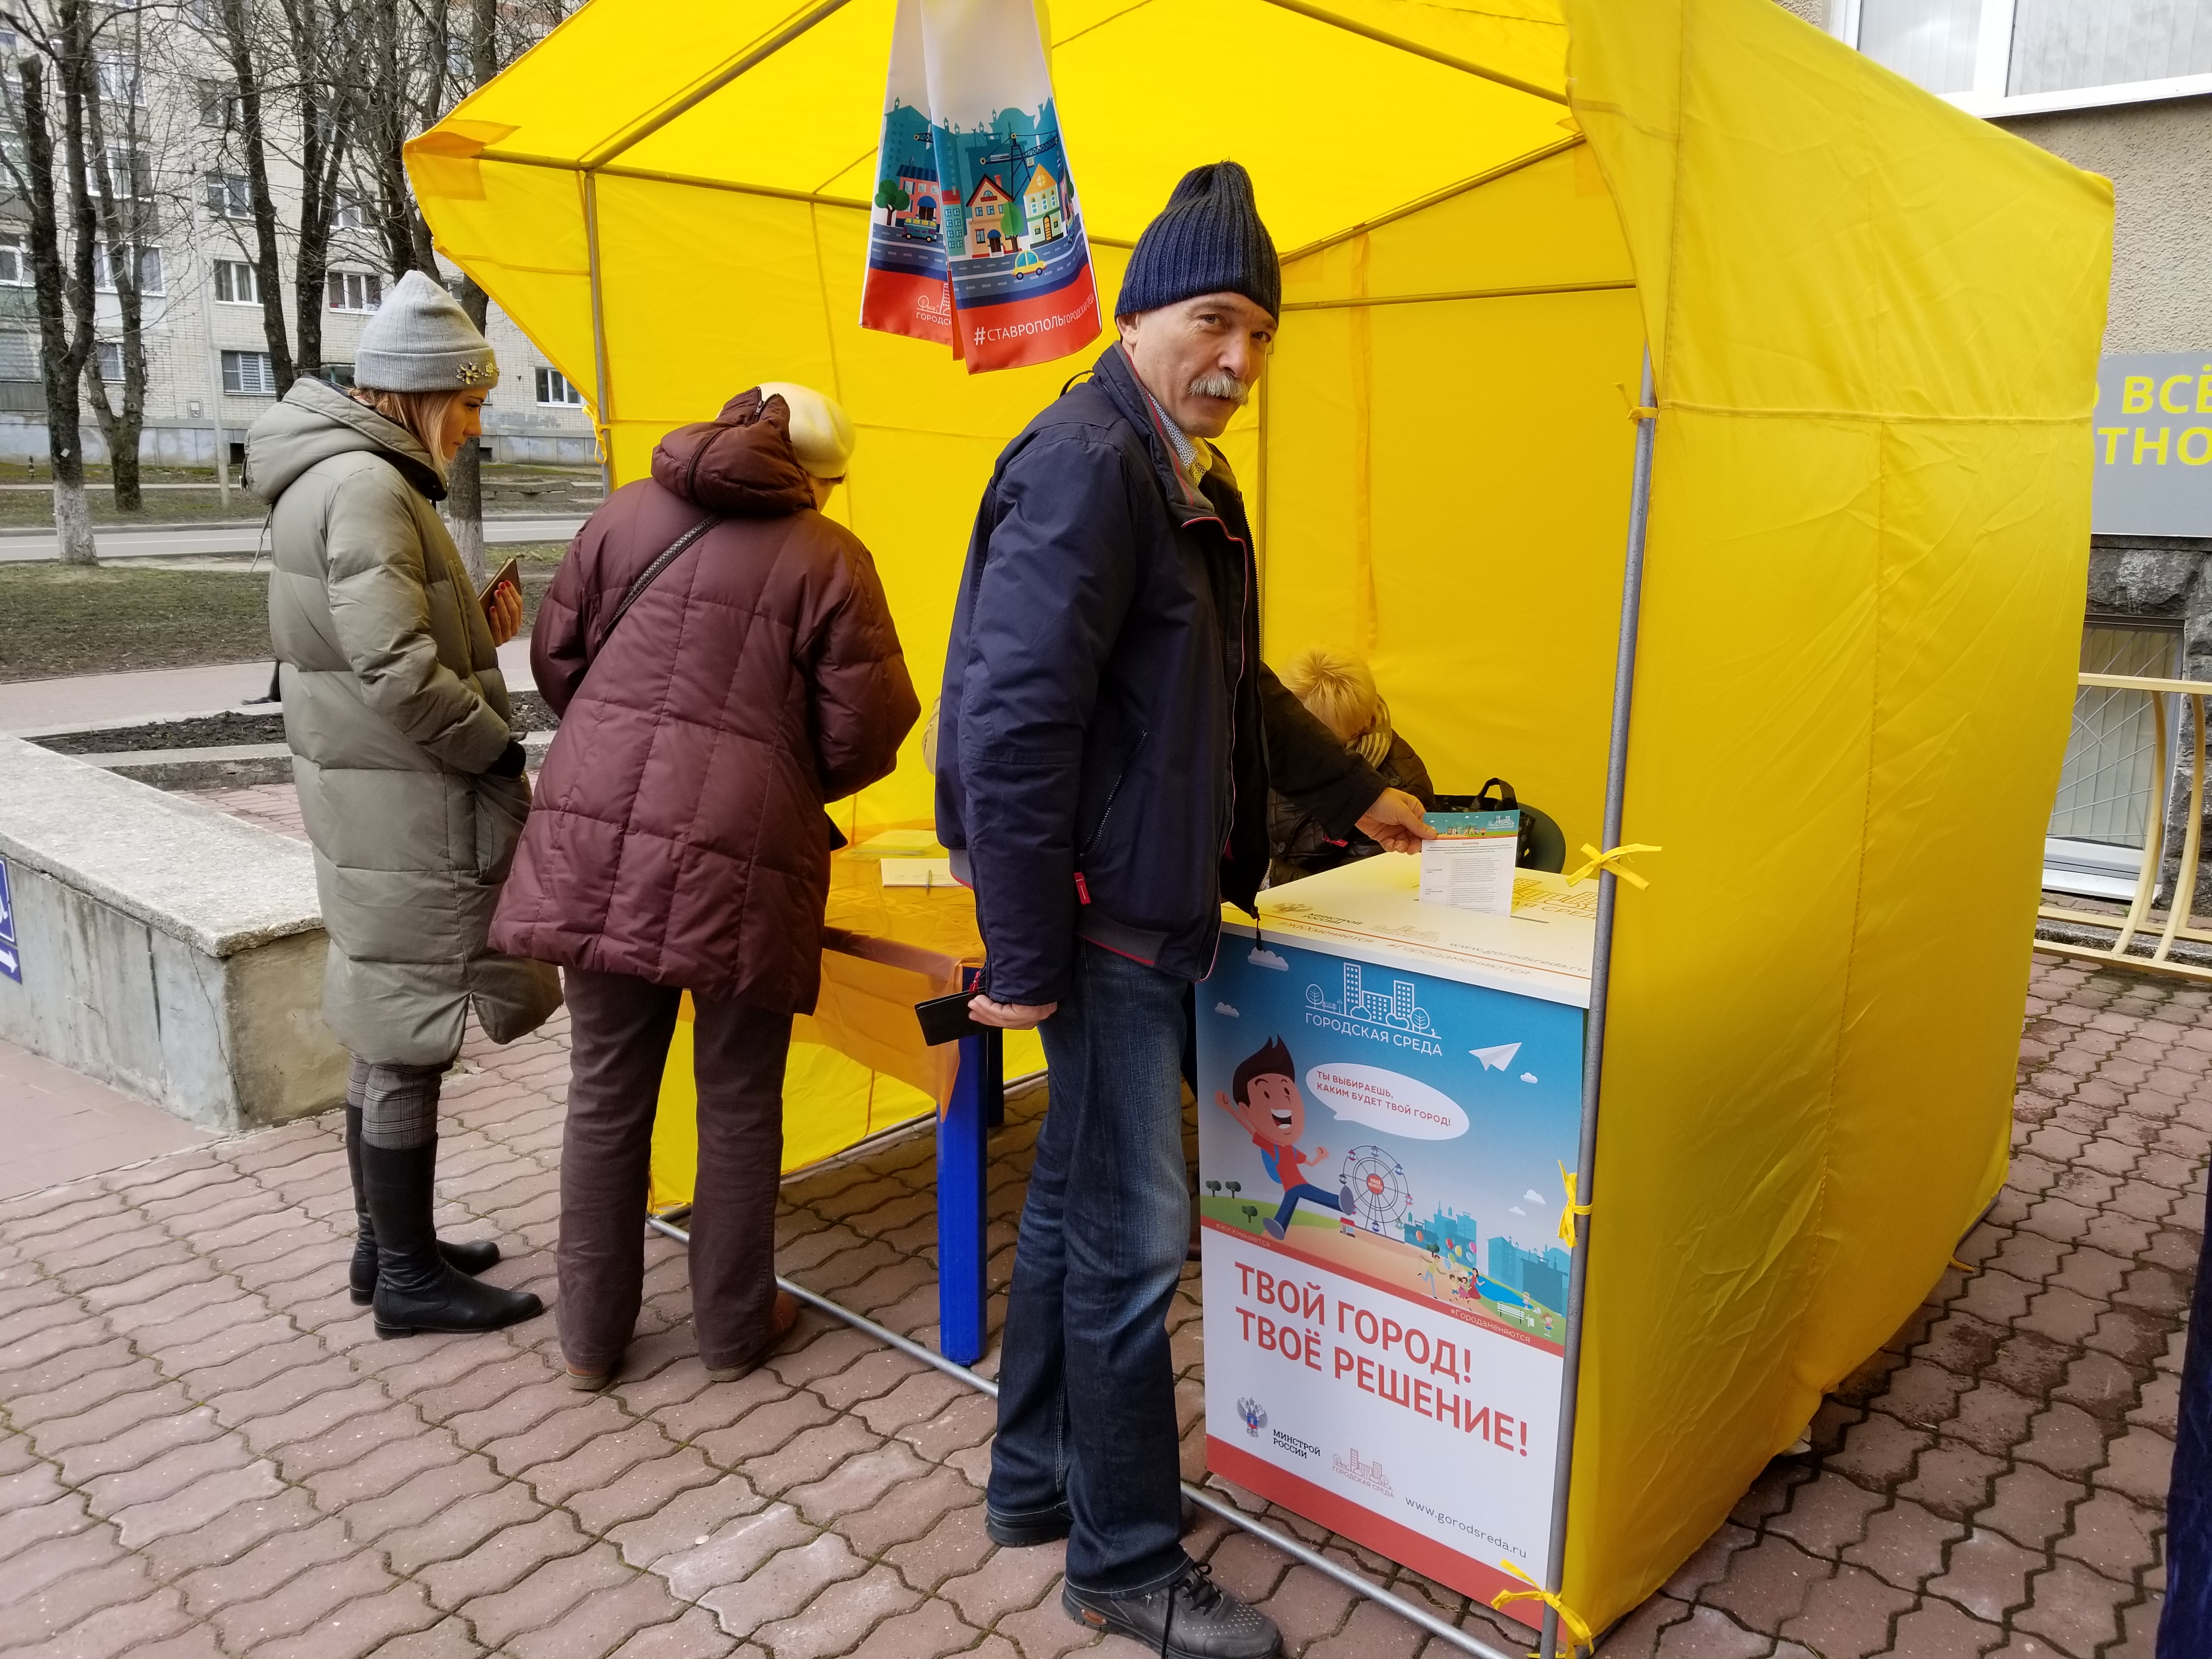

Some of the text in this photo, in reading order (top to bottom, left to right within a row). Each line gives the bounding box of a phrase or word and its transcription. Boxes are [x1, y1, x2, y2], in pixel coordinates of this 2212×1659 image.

[916, 312, 951, 326] ГОРОДС
[2097, 427, 2212, 465] ТНО
[1542, 906, 1596, 919] СРЕД
[1450, 943, 1587, 972] www.gorodsreda.ru
[1306, 1013, 1442, 1057] ГОРОДСКАЯ СРЕДА
[1317, 1071, 1394, 1099] ТЫ ВЫБИРАЕШЬ,
[1317, 1083, 1451, 1126] КАКИМ БУДЕТ ТВОЙ ГОРОД!
[1235, 1261, 1471, 1385] ТВОЙ ГОРОД!
[1451, 1309, 1530, 1343] #Городаменяются
[1235, 1306, 1527, 1457] ТВОЁ РЕШЕНИЕ!
[1273, 1429, 1321, 1457] МИНСТРОЙ
[1273, 1438, 1307, 1459] РОССИИ
[1333, 1466, 1394, 1498] ГОРОДСКАЯ СРЕДА
[1406, 1497, 1527, 1559] www.gorodsreda.ru
